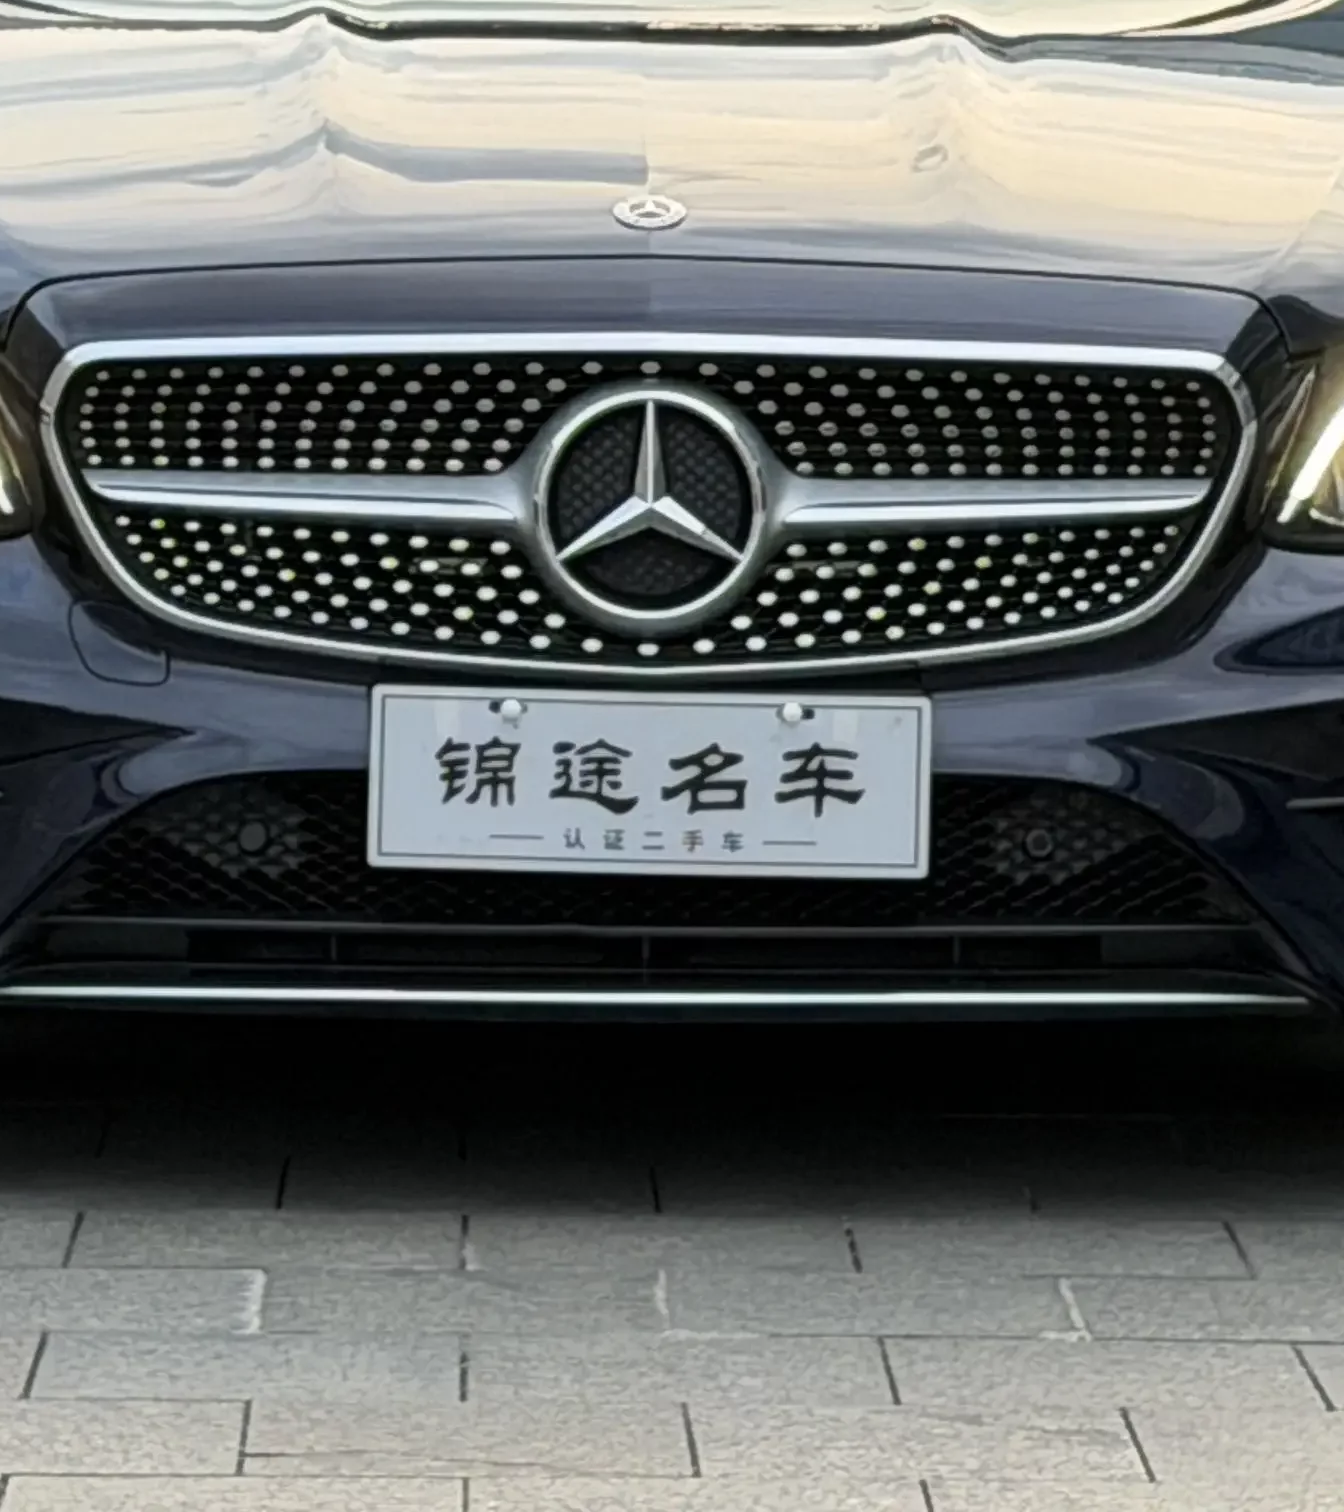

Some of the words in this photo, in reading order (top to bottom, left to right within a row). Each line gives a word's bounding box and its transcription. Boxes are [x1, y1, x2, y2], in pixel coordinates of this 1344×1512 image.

[434, 735, 866, 818] 锦途名车
[563, 827, 745, 854] 认证二手车
